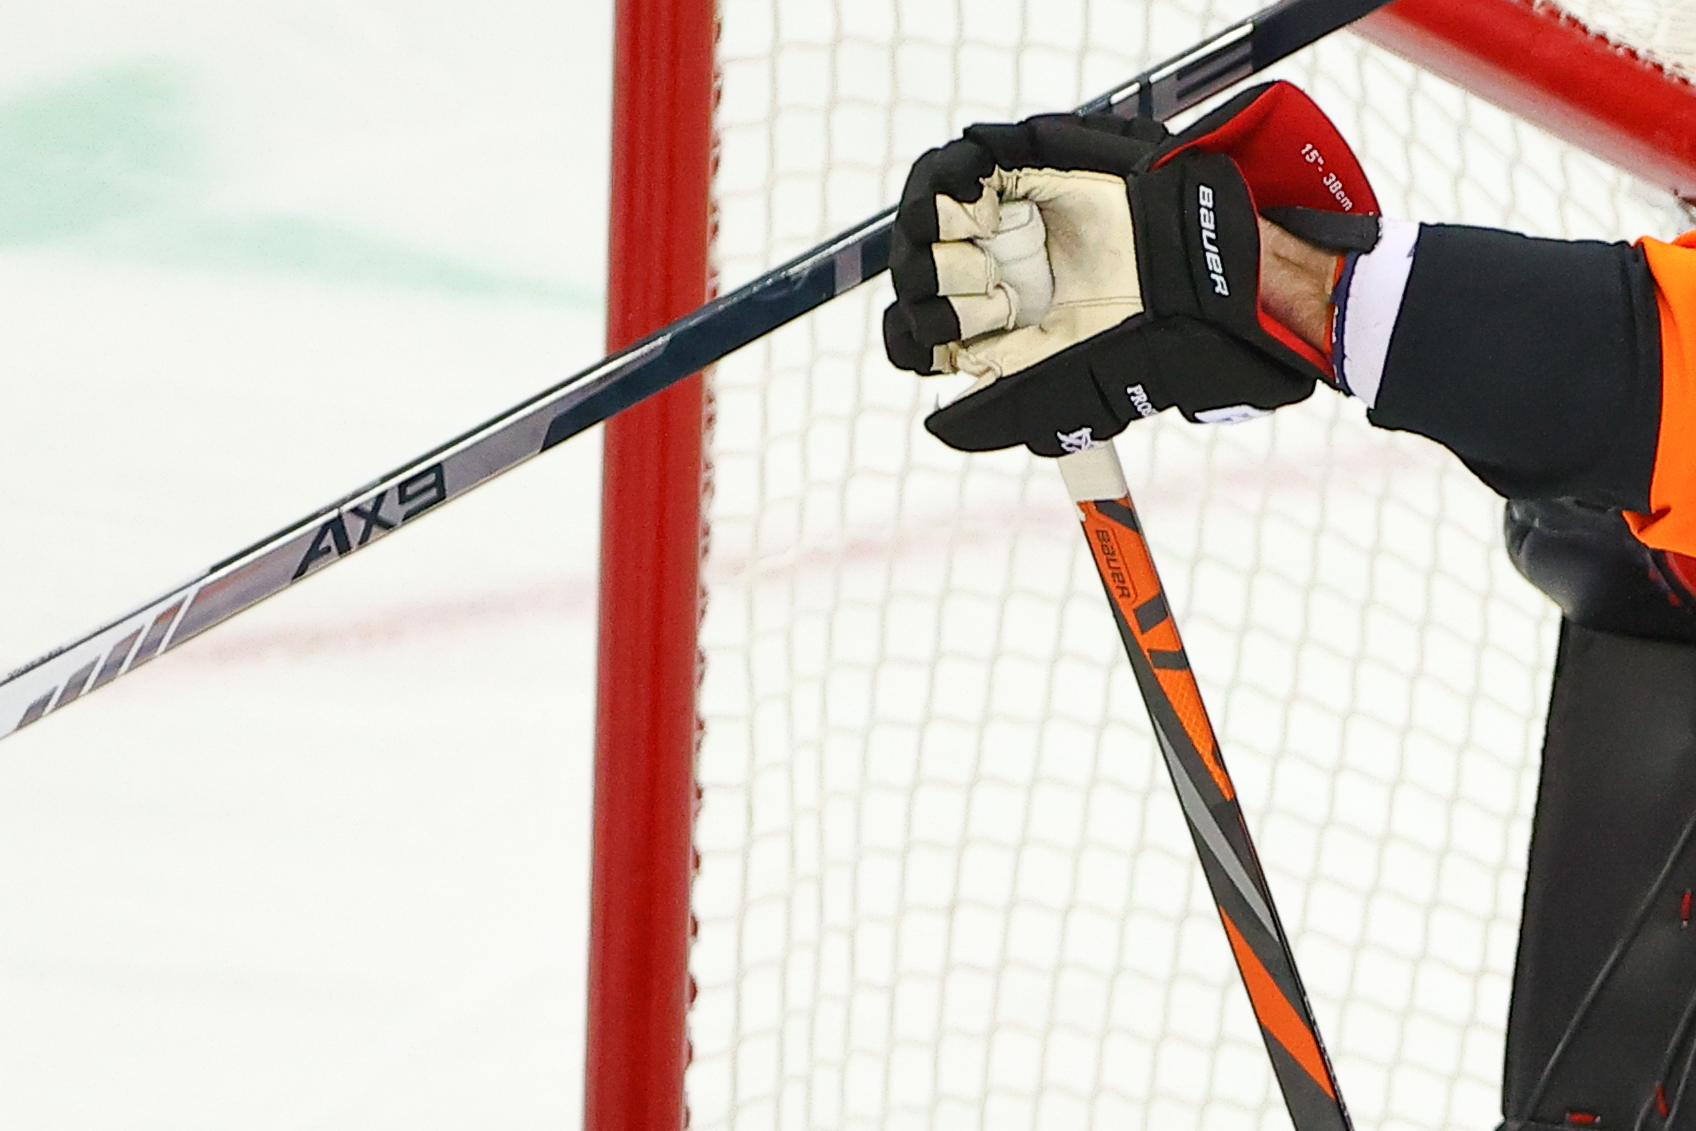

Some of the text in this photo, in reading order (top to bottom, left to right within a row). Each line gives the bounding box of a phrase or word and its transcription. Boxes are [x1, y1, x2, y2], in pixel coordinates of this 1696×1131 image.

[1322, 172, 1353, 212] 38cm
[1199, 185, 1229, 296] BAUER
[291, 462, 447, 583] AX9
[1095, 529, 1131, 599] BAUER
